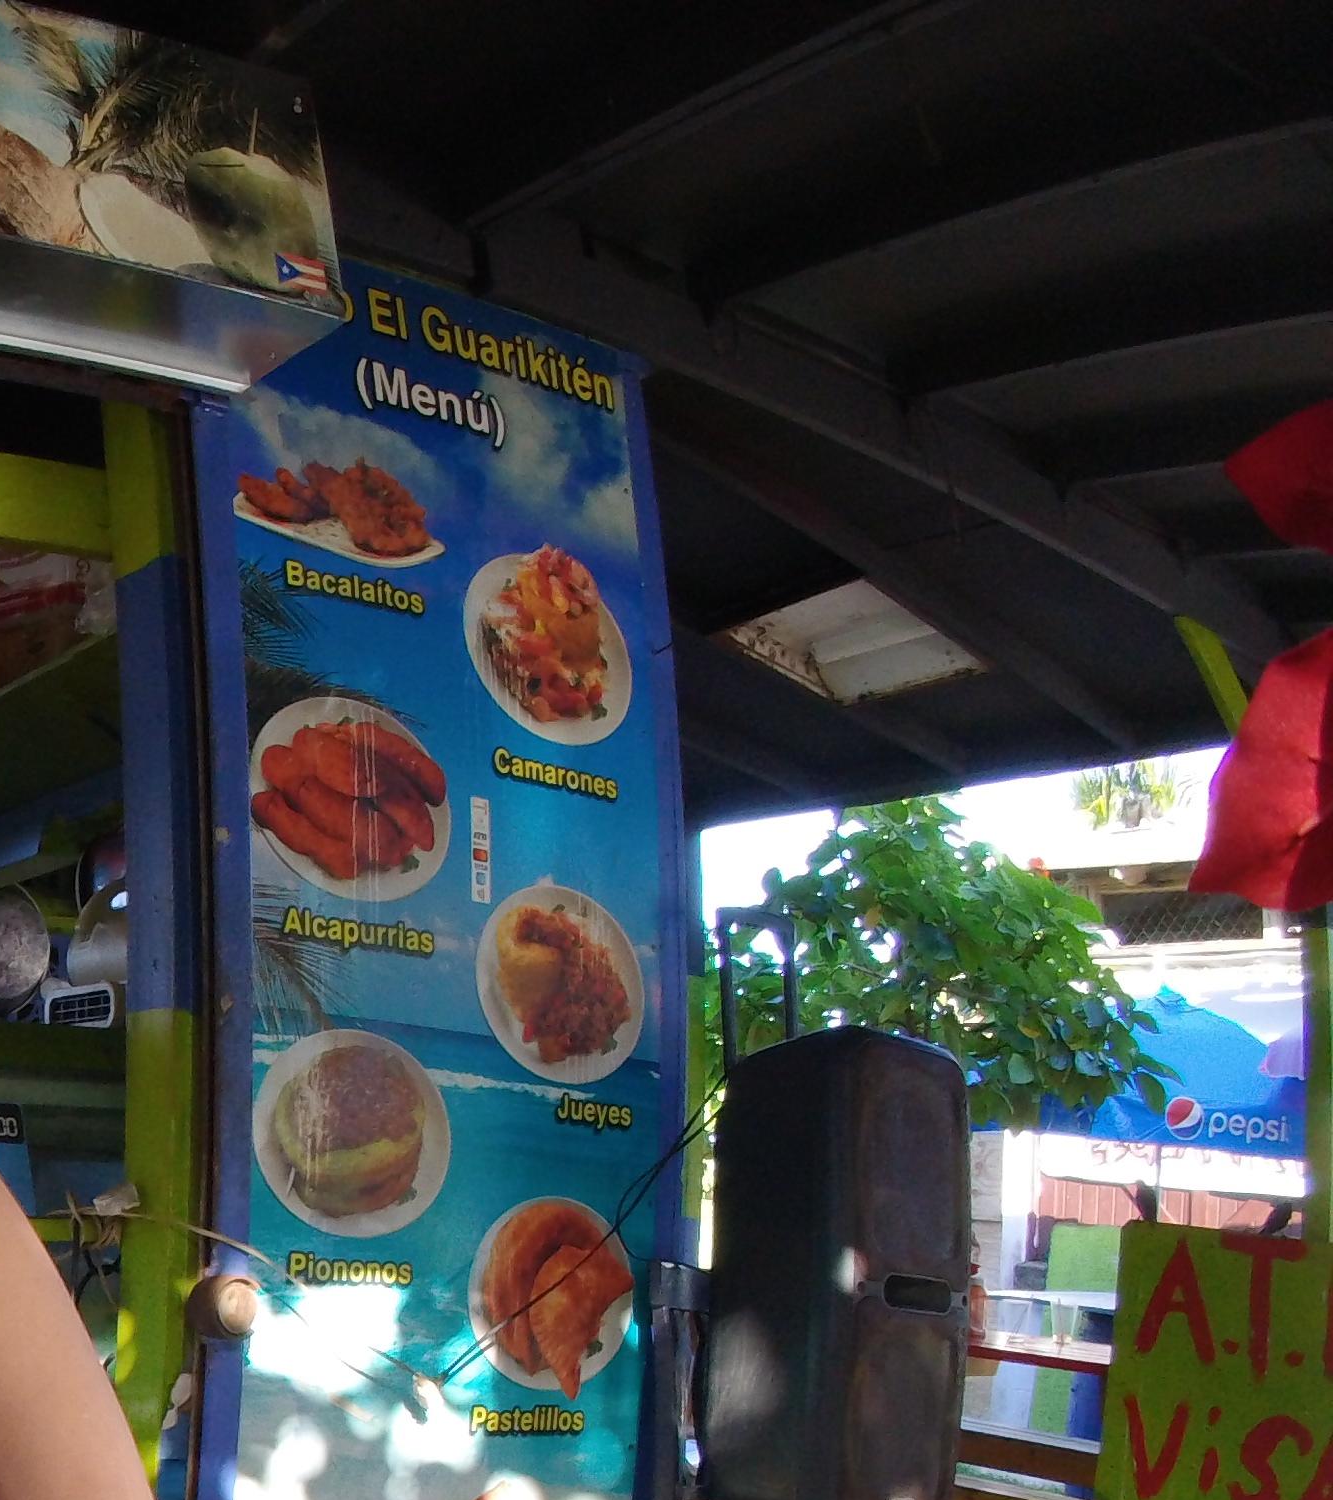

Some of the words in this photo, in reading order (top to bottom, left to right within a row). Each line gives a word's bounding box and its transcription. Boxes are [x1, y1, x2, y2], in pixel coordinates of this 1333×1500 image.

[367, 288, 409, 341] El
[420, 306, 616, 412] Guarikitén
[355, 357, 506, 449] (Menú)
[493, 747, 620, 801] Camarones
[282, 907, 435, 957] Alcapurrias
[555, 1093, 633, 1129] Jueyes
[1208, 1111, 1289, 1144] pepsi
[286, 1251, 414, 1287] Piononos
[1134, 1232, 1333, 1384] A.T.
[469, 1404, 586, 1434] Pastelillos
